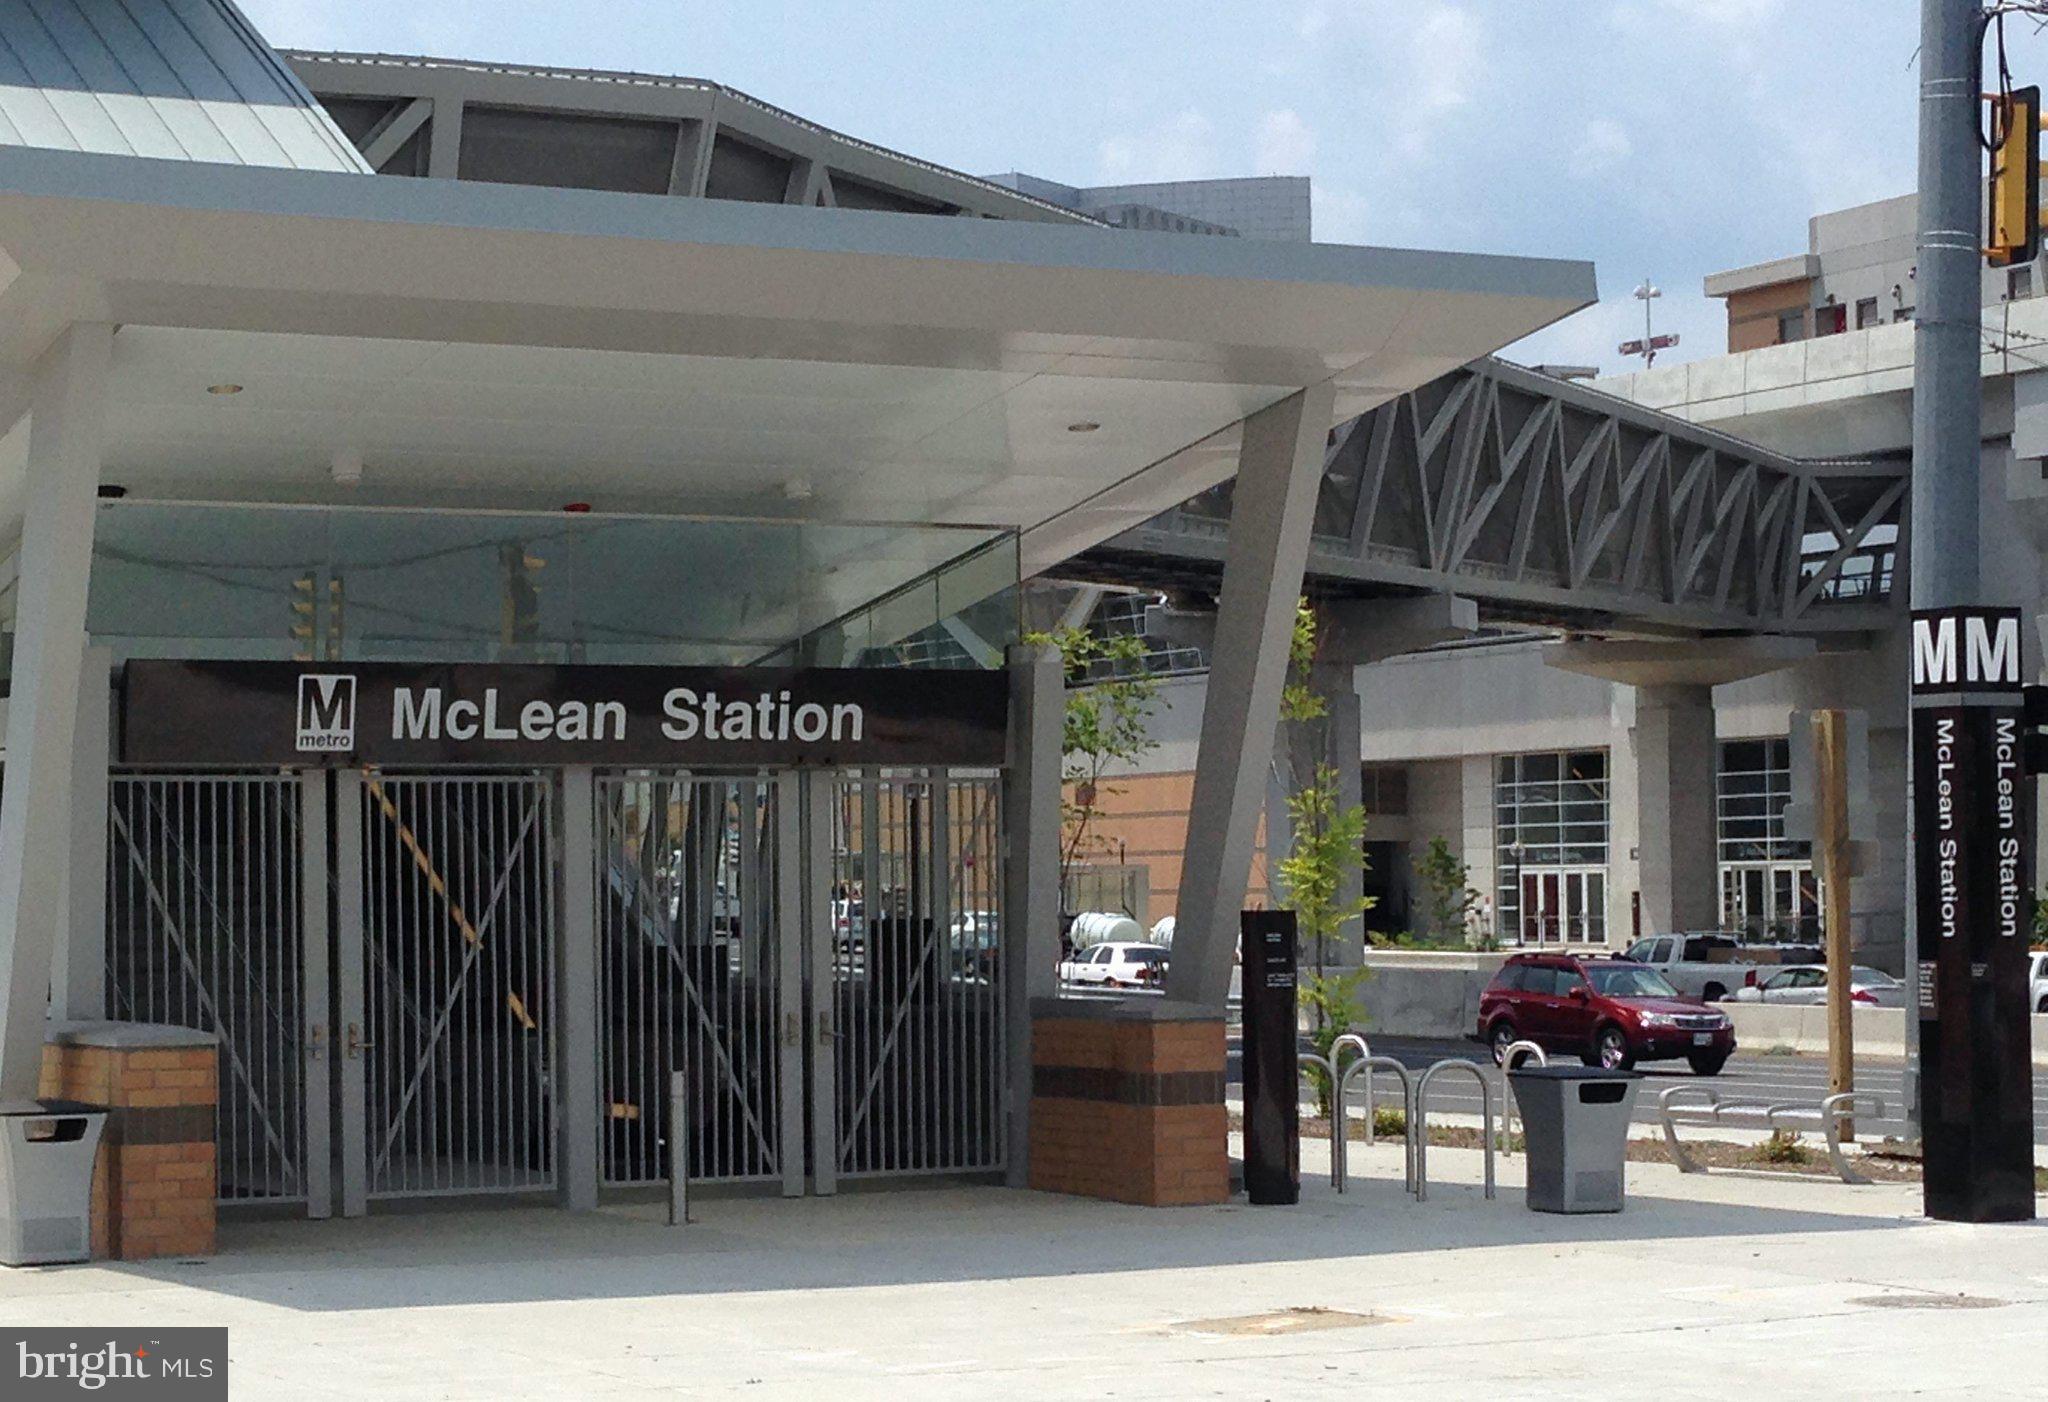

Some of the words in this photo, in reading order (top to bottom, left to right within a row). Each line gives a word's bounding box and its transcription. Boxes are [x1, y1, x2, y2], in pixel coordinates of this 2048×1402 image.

[1912, 618, 1957, 684] M
[1965, 617, 2019, 682] M
[301, 678, 351, 731] M
[392, 687, 626, 741] McLean
[660, 688, 864, 742] Station
[300, 734, 350, 748] metro
[1995, 718, 2016, 829] McLean
[1936, 719, 1954, 830] McLean
[1938, 838, 1957, 938] Station
[1999, 837, 2019, 937] Station
